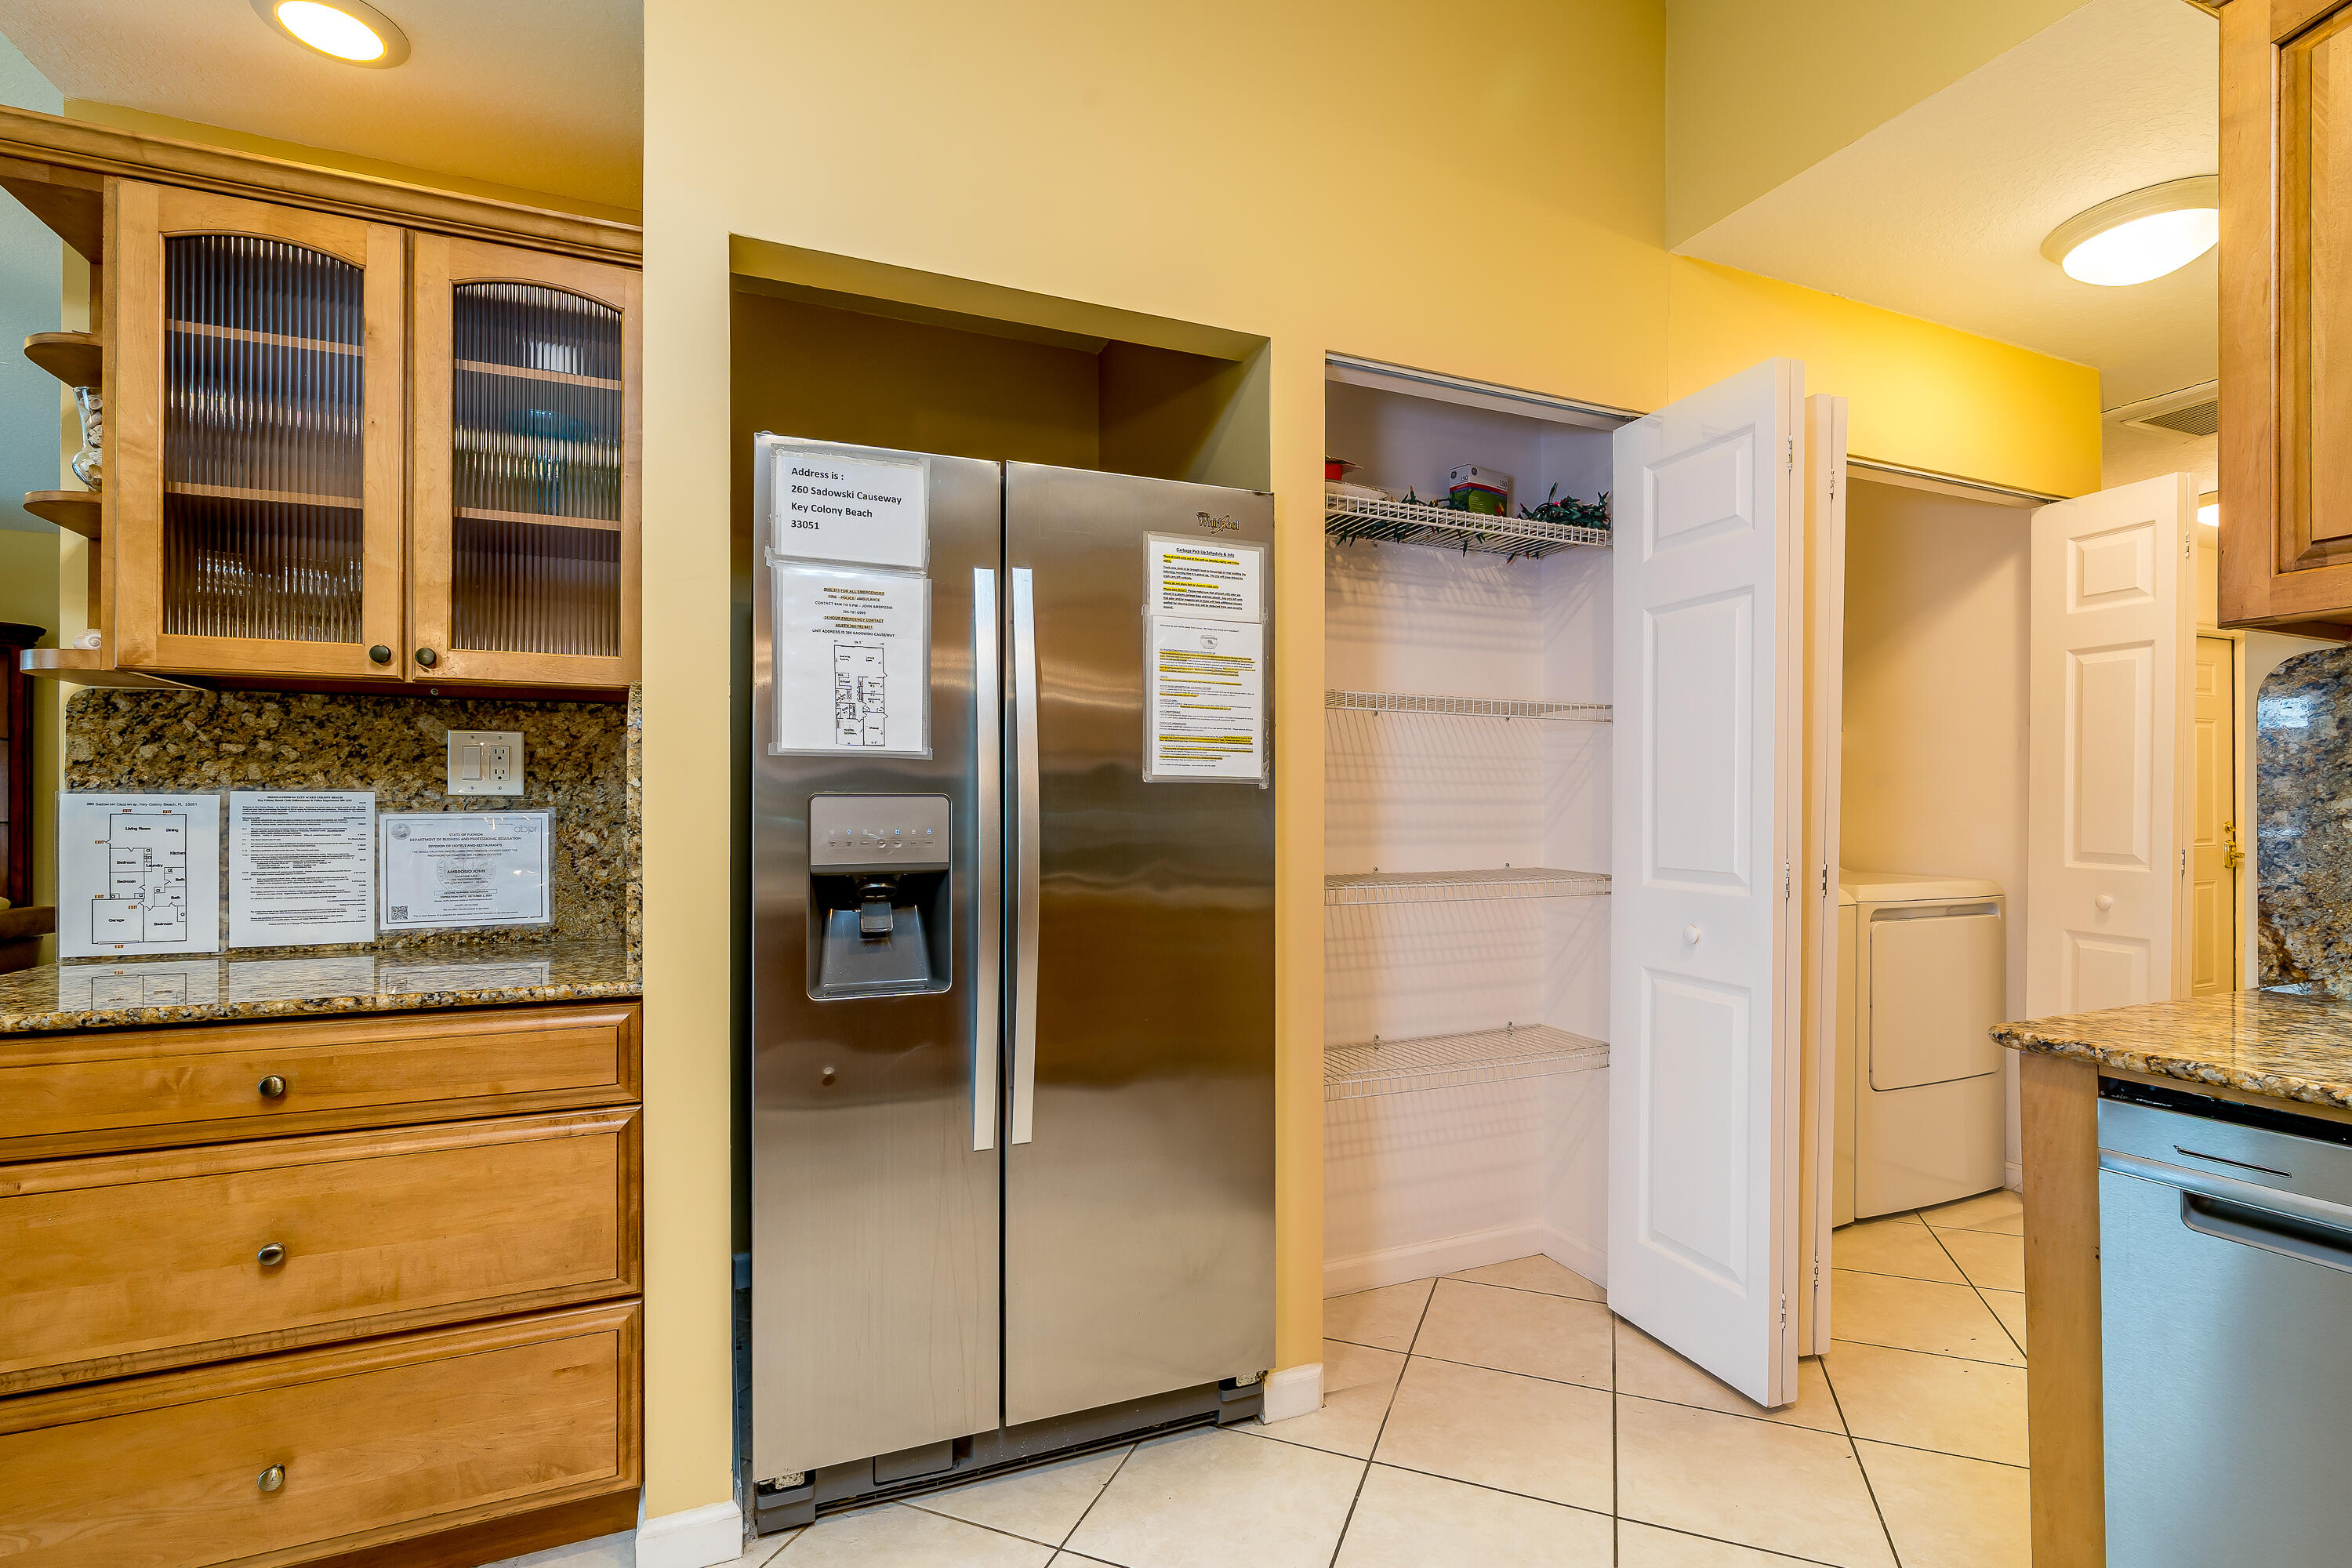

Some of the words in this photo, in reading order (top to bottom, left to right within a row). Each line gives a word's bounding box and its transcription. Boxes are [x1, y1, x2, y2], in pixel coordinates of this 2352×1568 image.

[791, 467, 829, 479] Address
[831, 471, 839, 480] is
[791, 485, 808, 494] 260
[811, 486, 855, 499] Sadowski
[857, 492, 902, 505] Causeway
[791, 502, 808, 513] Key
[811, 504, 843, 516] Colony
[845, 507, 873, 517] Beach
[791, 520, 820, 530] 33051
[1197, 515, 1240, 534] Whirlpool
[514, 825, 538, 834] dbpr
